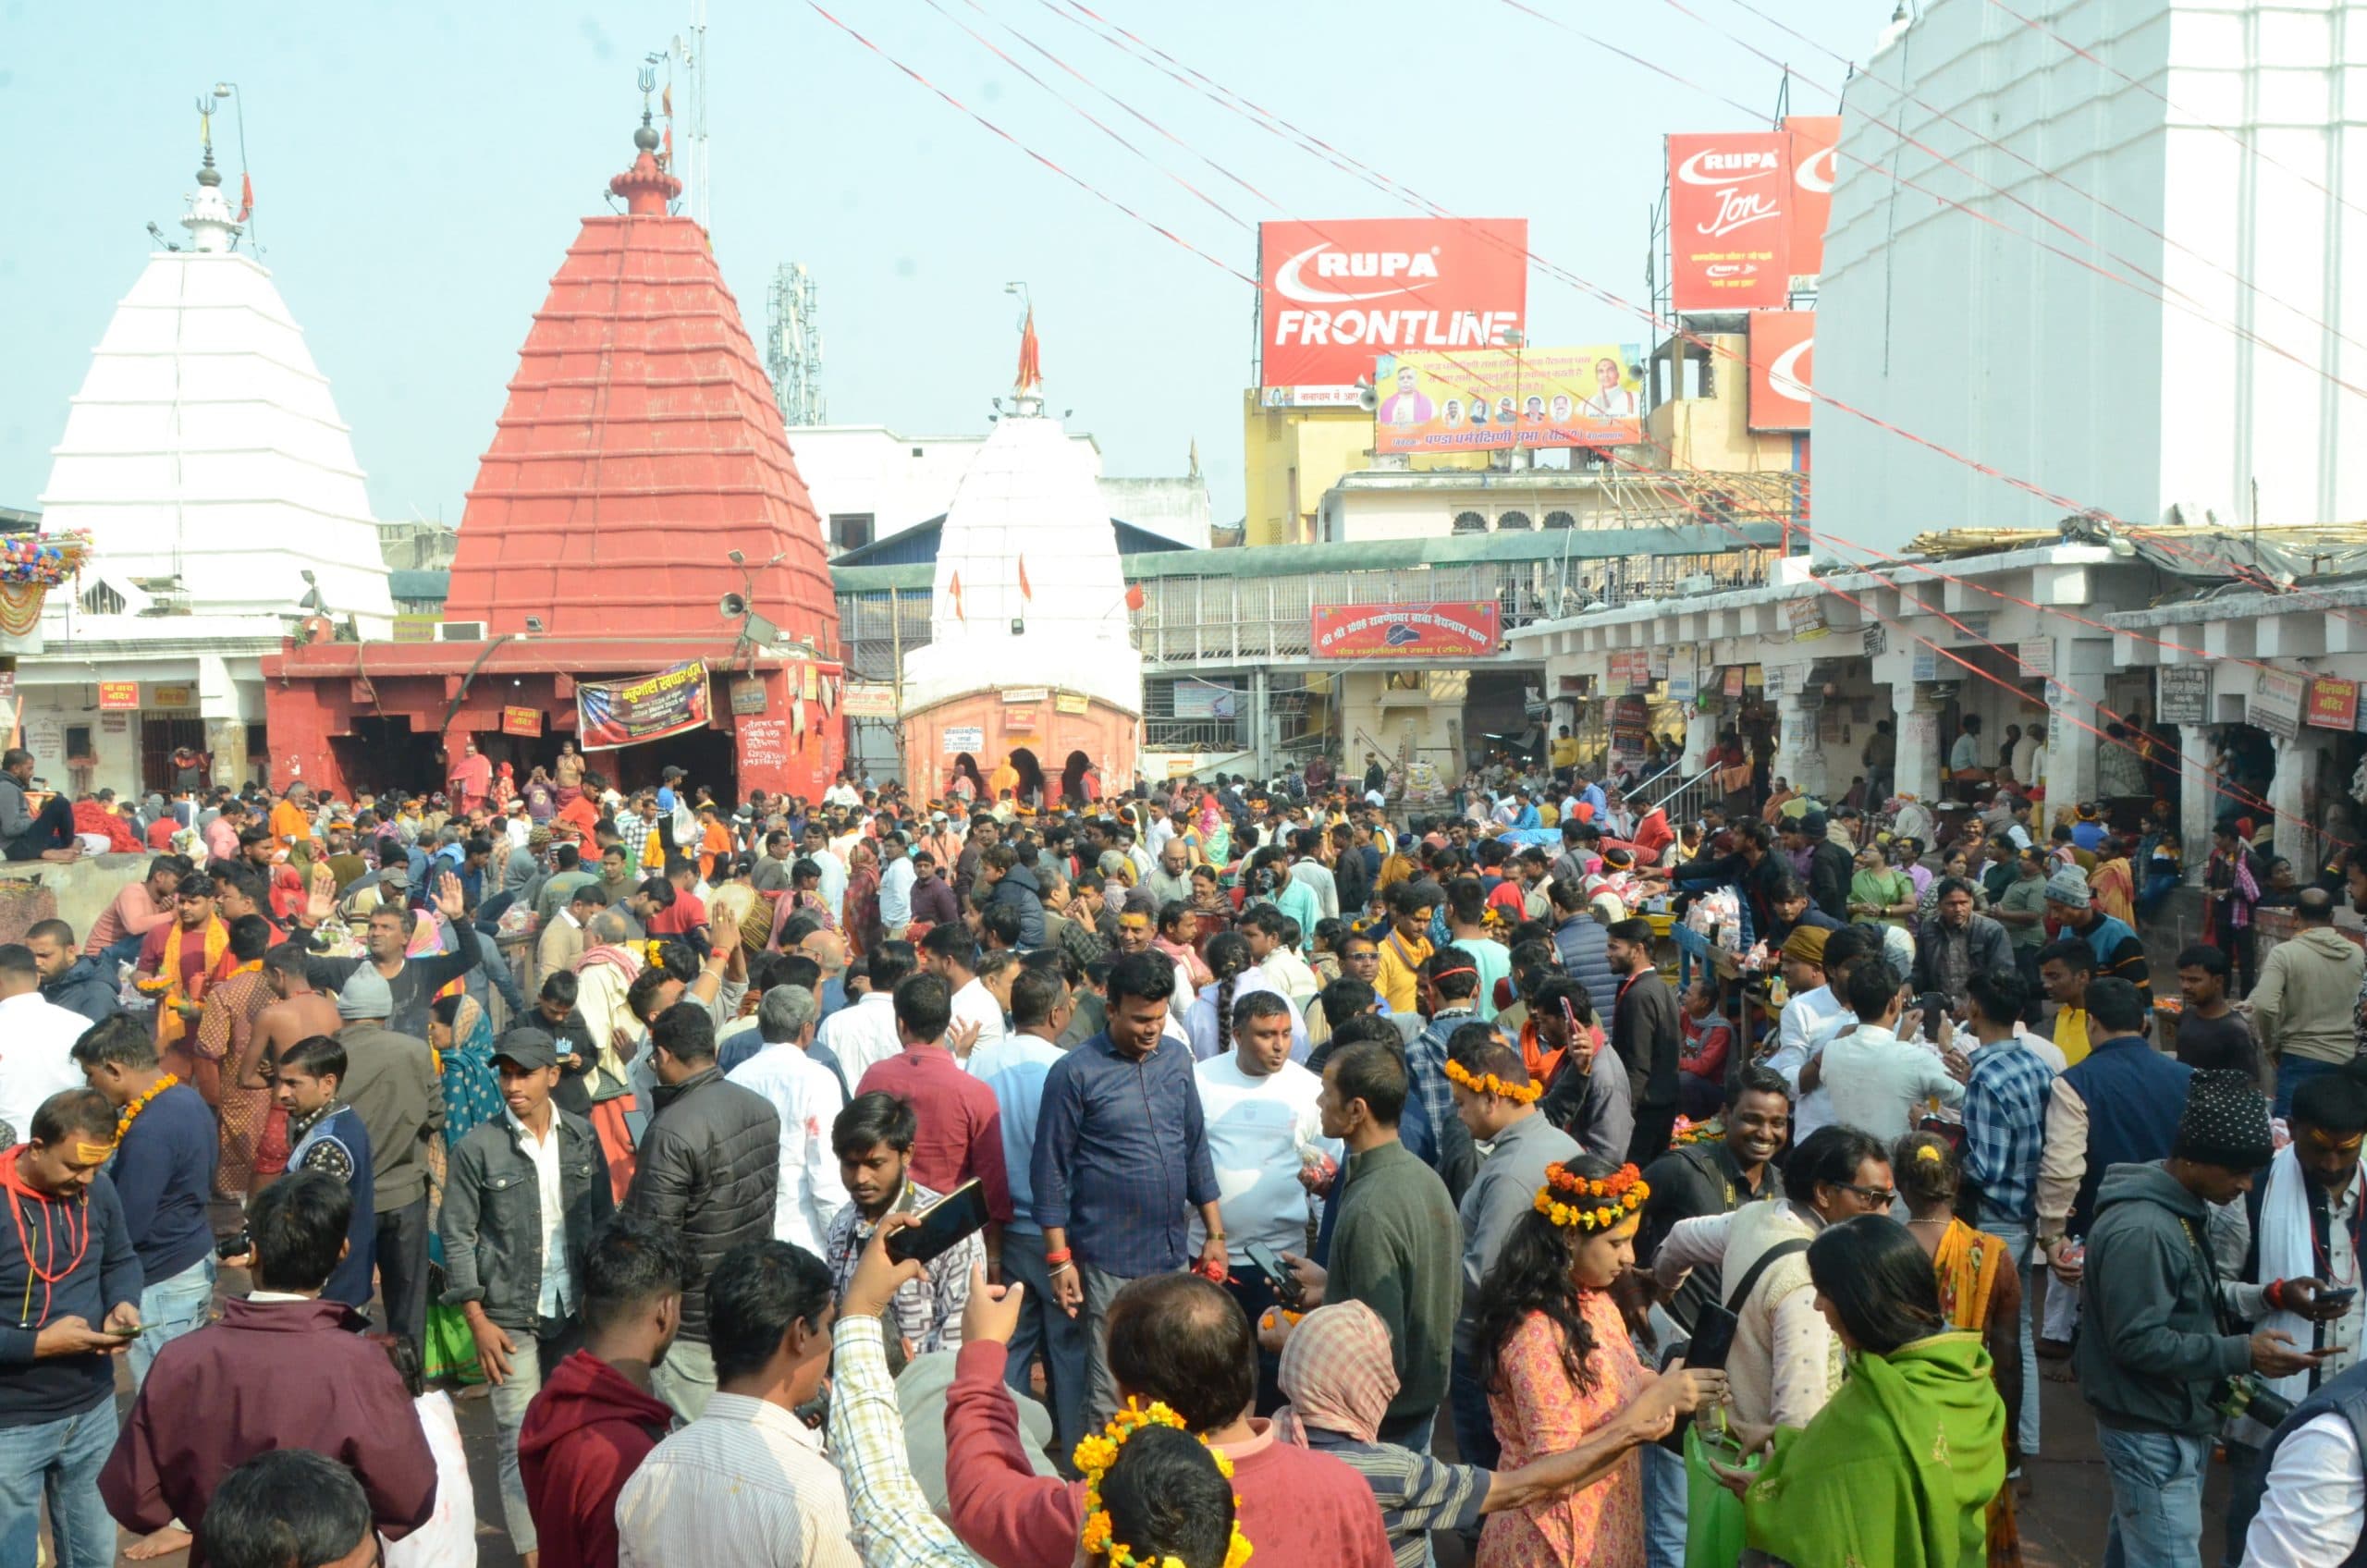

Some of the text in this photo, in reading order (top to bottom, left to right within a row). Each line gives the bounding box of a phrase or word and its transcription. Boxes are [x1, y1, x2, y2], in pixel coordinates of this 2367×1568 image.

[1704, 153, 1779, 169] RUPA
[1697, 187, 1776, 234] Jon
[1318, 251, 1438, 277] RUPA
[1275, 309, 1518, 346] FRONTLINE
[2320, 696, 2346, 711] मंदिर
